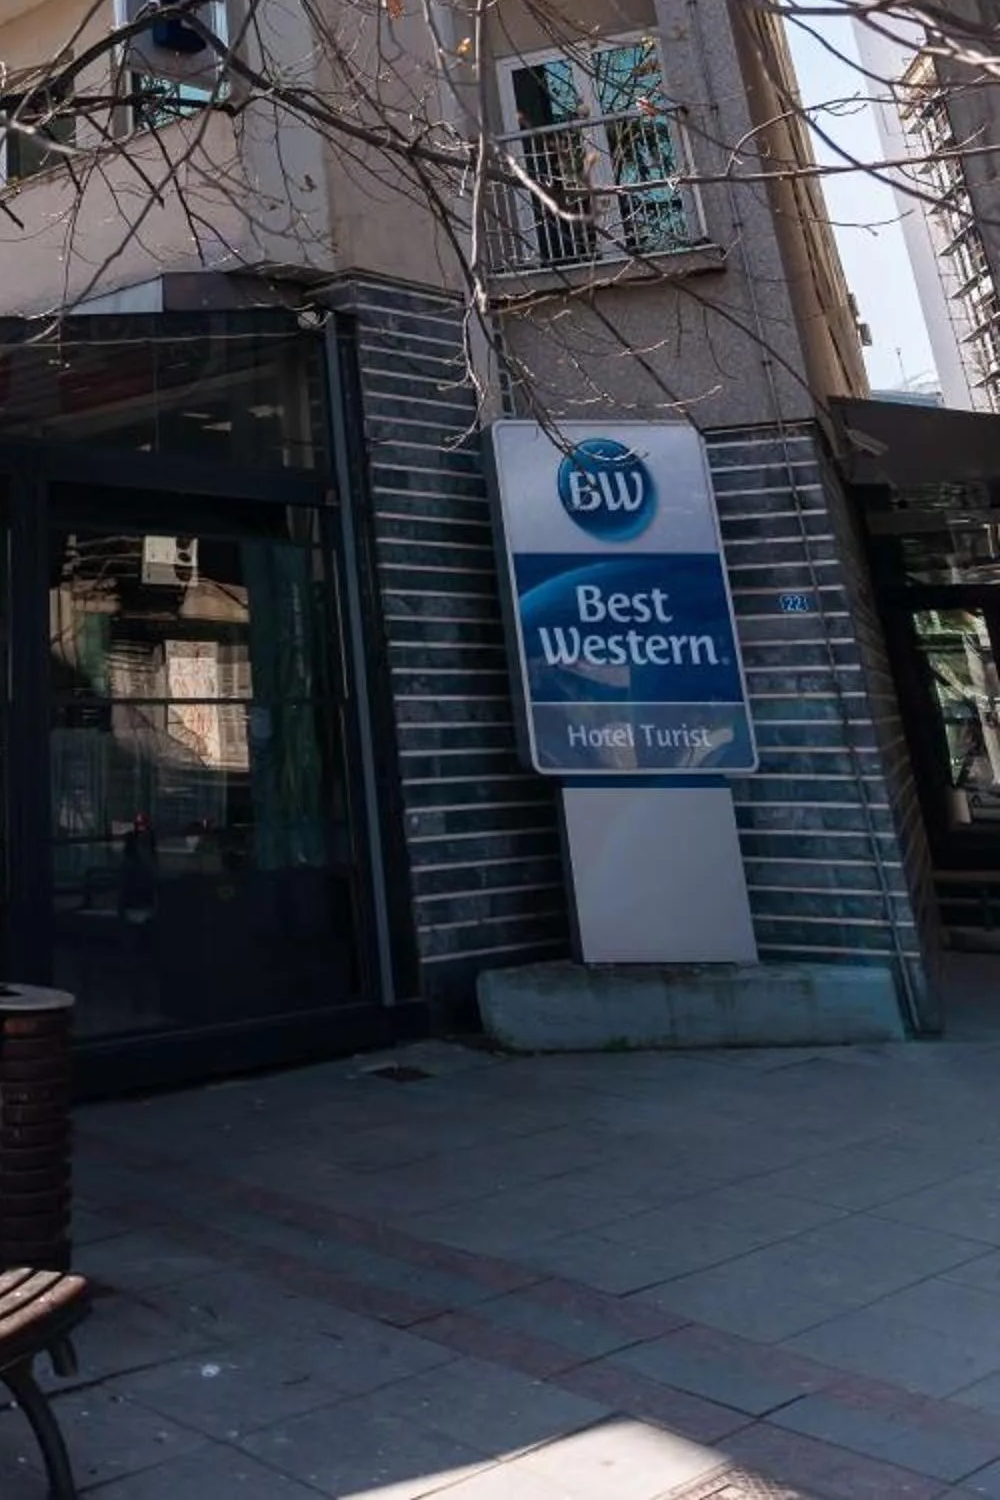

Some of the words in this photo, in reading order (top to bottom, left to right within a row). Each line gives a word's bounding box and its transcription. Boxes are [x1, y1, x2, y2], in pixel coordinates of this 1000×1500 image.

[568, 471, 644, 511] BW
[576, 585, 674, 623] Best
[537, 626, 720, 666] Western
[567, 723, 636, 747] Hotel
[640, 723, 713, 747] Turist
